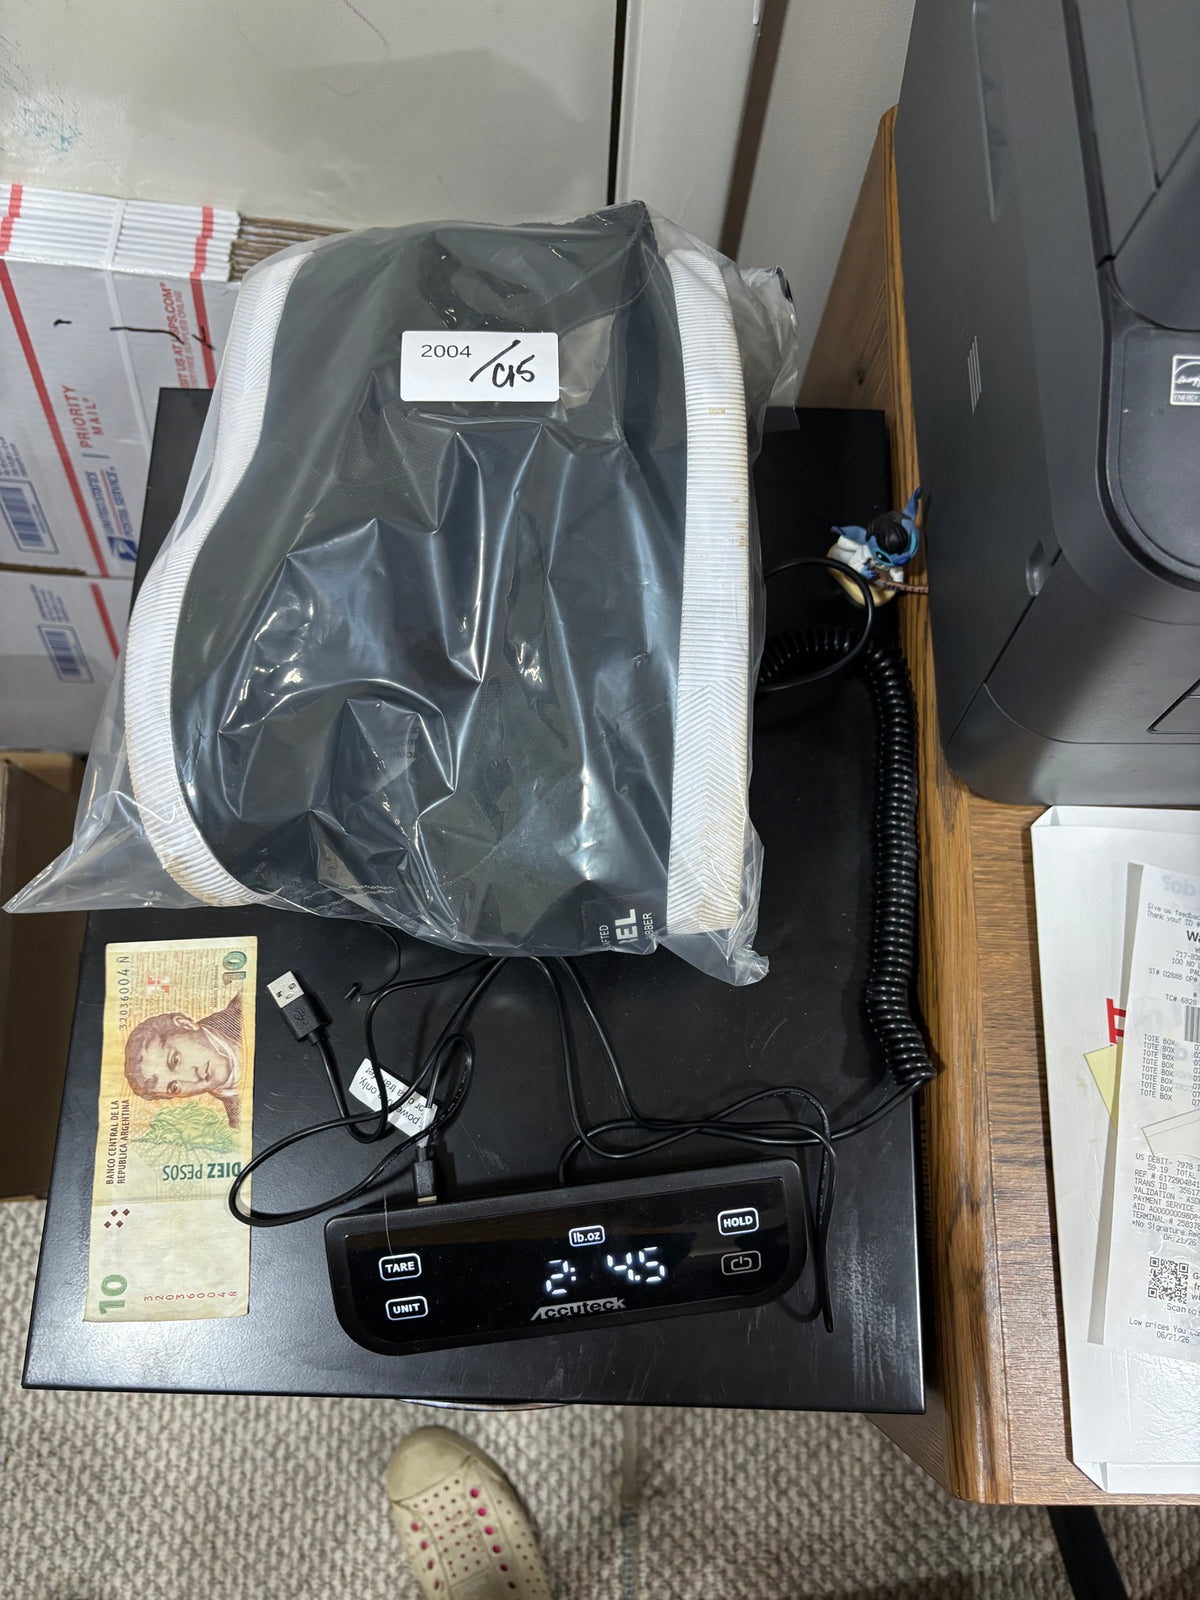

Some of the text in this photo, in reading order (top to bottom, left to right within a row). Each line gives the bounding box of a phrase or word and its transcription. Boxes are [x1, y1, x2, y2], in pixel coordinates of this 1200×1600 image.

[421, 344, 472, 358] 2004
[61, 384, 93, 448] PRIORITY
[614, 908, 639, 944] EL
[222, 950, 247, 986] 10
[119, 968, 130, 1030] 32036004
[1144, 1034, 1160, 1043] TOTE
[1163, 1038, 1175, 1046] BOX
[1144, 1042, 1159, 1051] TOTE
[1162, 1045, 1175, 1053] BOX
[1143, 1049, 1158, 1058] TOTE
[1162, 1053, 1174, 1061] BOX
[1142, 1057, 1158, 1066] TOTE
[1162, 1061, 1174, 1069] BOX
[1142, 1065, 1158, 1074] TOTE
[1161, 1068, 1174, 1077] BOX
[1142, 1073, 1157, 1082] TOTE
[1161, 1077, 1173, 1085] BOX
[1141, 1081, 1157, 1090] TOTE
[1160, 1085, 1172, 1093] BOX
[1141, 1089, 1157, 1098] TOTE
[1160, 1092, 1172, 1101] BOX
[395, 1105, 421, 1125] powe
[105, 1100, 119, 1185] BANCO CENTRAL DE LA
[116, 1098, 130, 1184] REPUBLICA ARGENTINA
[1135, 1152, 1145, 1161] US
[162, 1161, 242, 1181] DIEZ PESOS
[1134, 1168, 1147, 1177] REF
[1176, 1168, 1196, 1179] TOTAL
[1134, 1177, 1155, 1188] TRANS
[1159, 1181, 1167, 1190] ID
[1134, 1185, 1175, 1200] VALIDATION
[1133, 1193, 1194, 1212] PAYMENT SERVICE
[1133, 1202, 1145, 1211] AID
[723, 1215, 753, 1229] HOLD
[1133, 1210, 1165, 1223] TERMINAL
[1147, 1221, 1185, 1236] Signature
[573, 1231, 601, 1243] lb.oz
[385, 1261, 415, 1274] TARE
[98, 1273, 128, 1315] 10
[392, 1303, 420, 1314] UNIT
[530, 1297, 626, 1321] Accuteck
[1166, 1302, 1186, 1313] Scan
[1129, 1317, 1142, 1326] Low
[1145, 1321, 1170, 1331] prices
[1173, 1325, 1186, 1334] You
